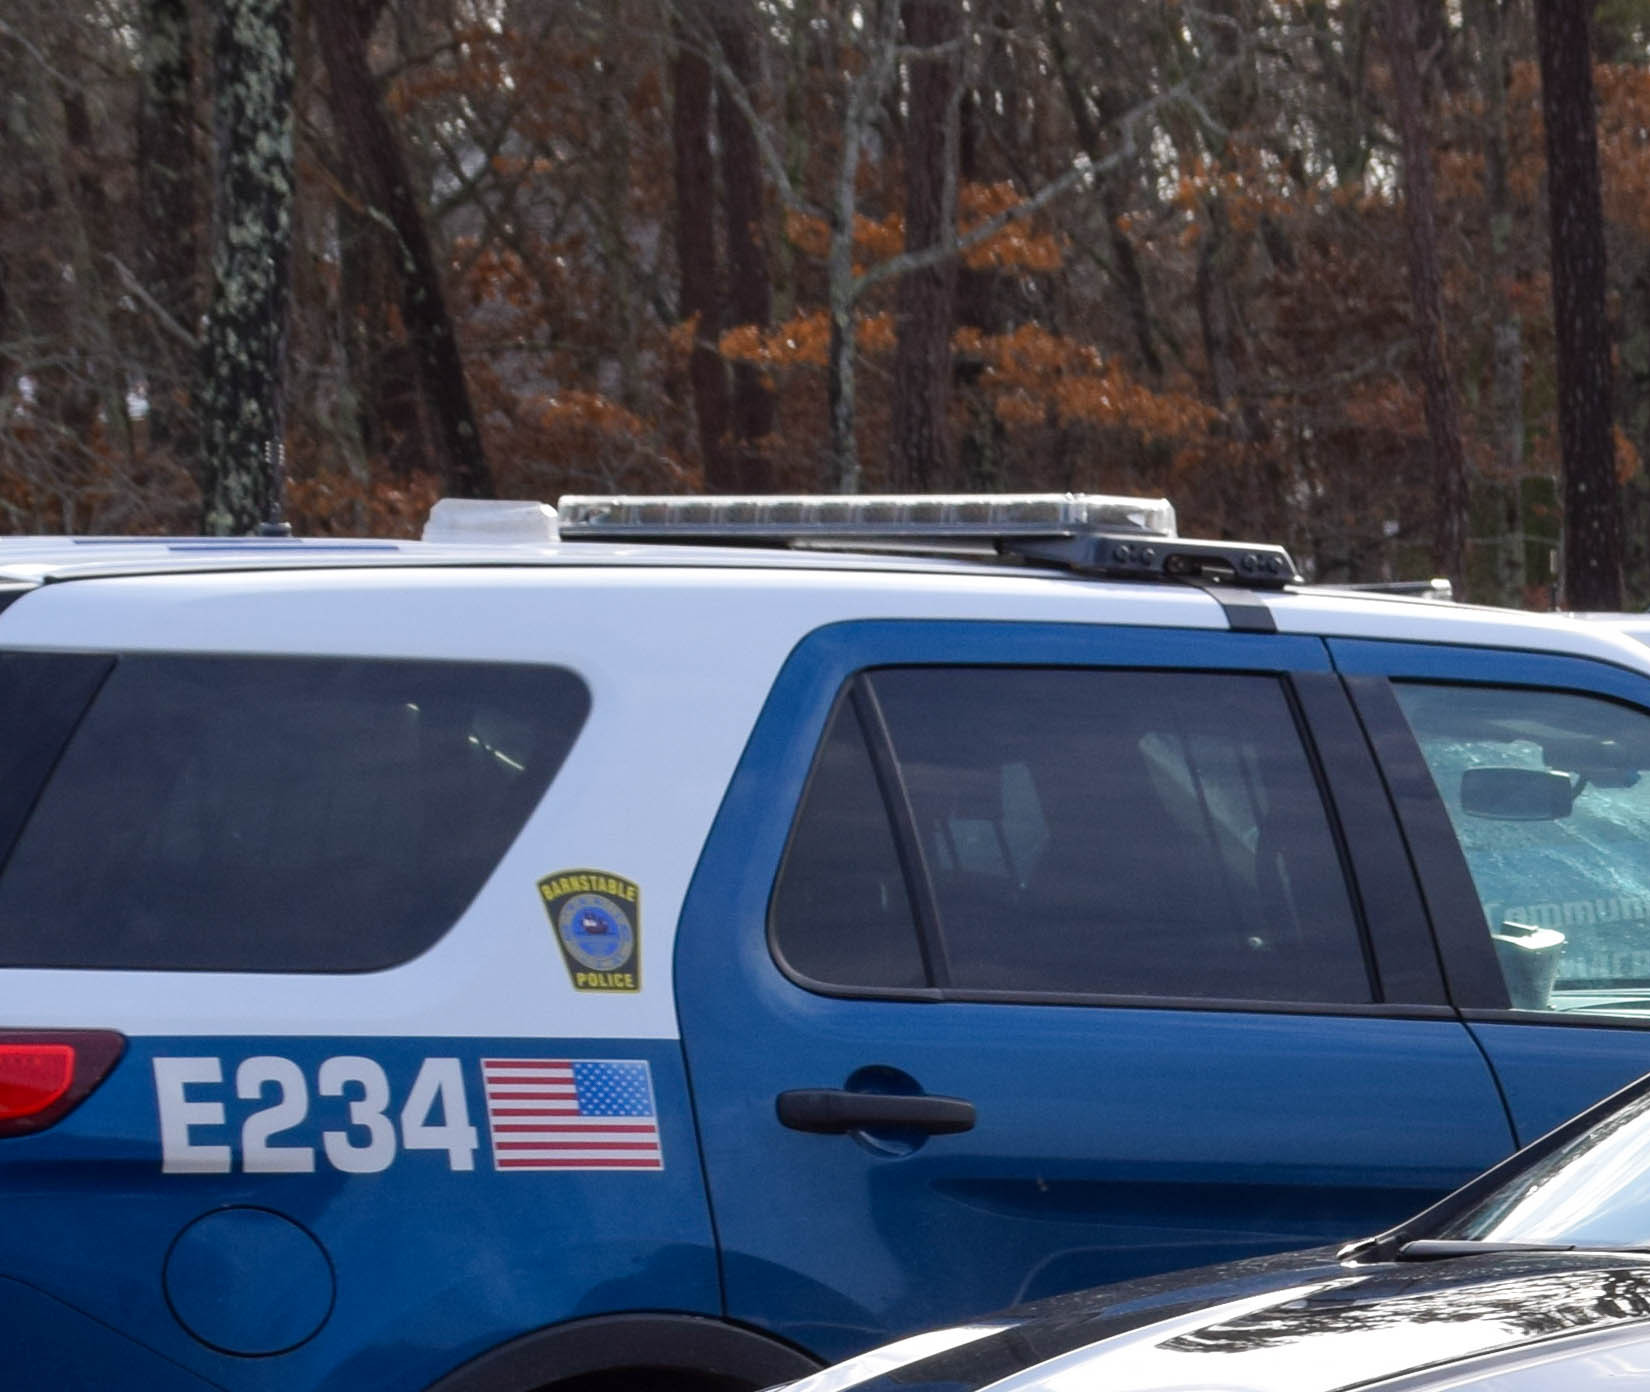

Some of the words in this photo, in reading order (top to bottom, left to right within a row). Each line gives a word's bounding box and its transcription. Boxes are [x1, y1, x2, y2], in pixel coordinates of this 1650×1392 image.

[541, 875, 637, 902] BARNSTABLE
[576, 972, 634, 988] POLICE
[152, 1056, 478, 1174] E234
